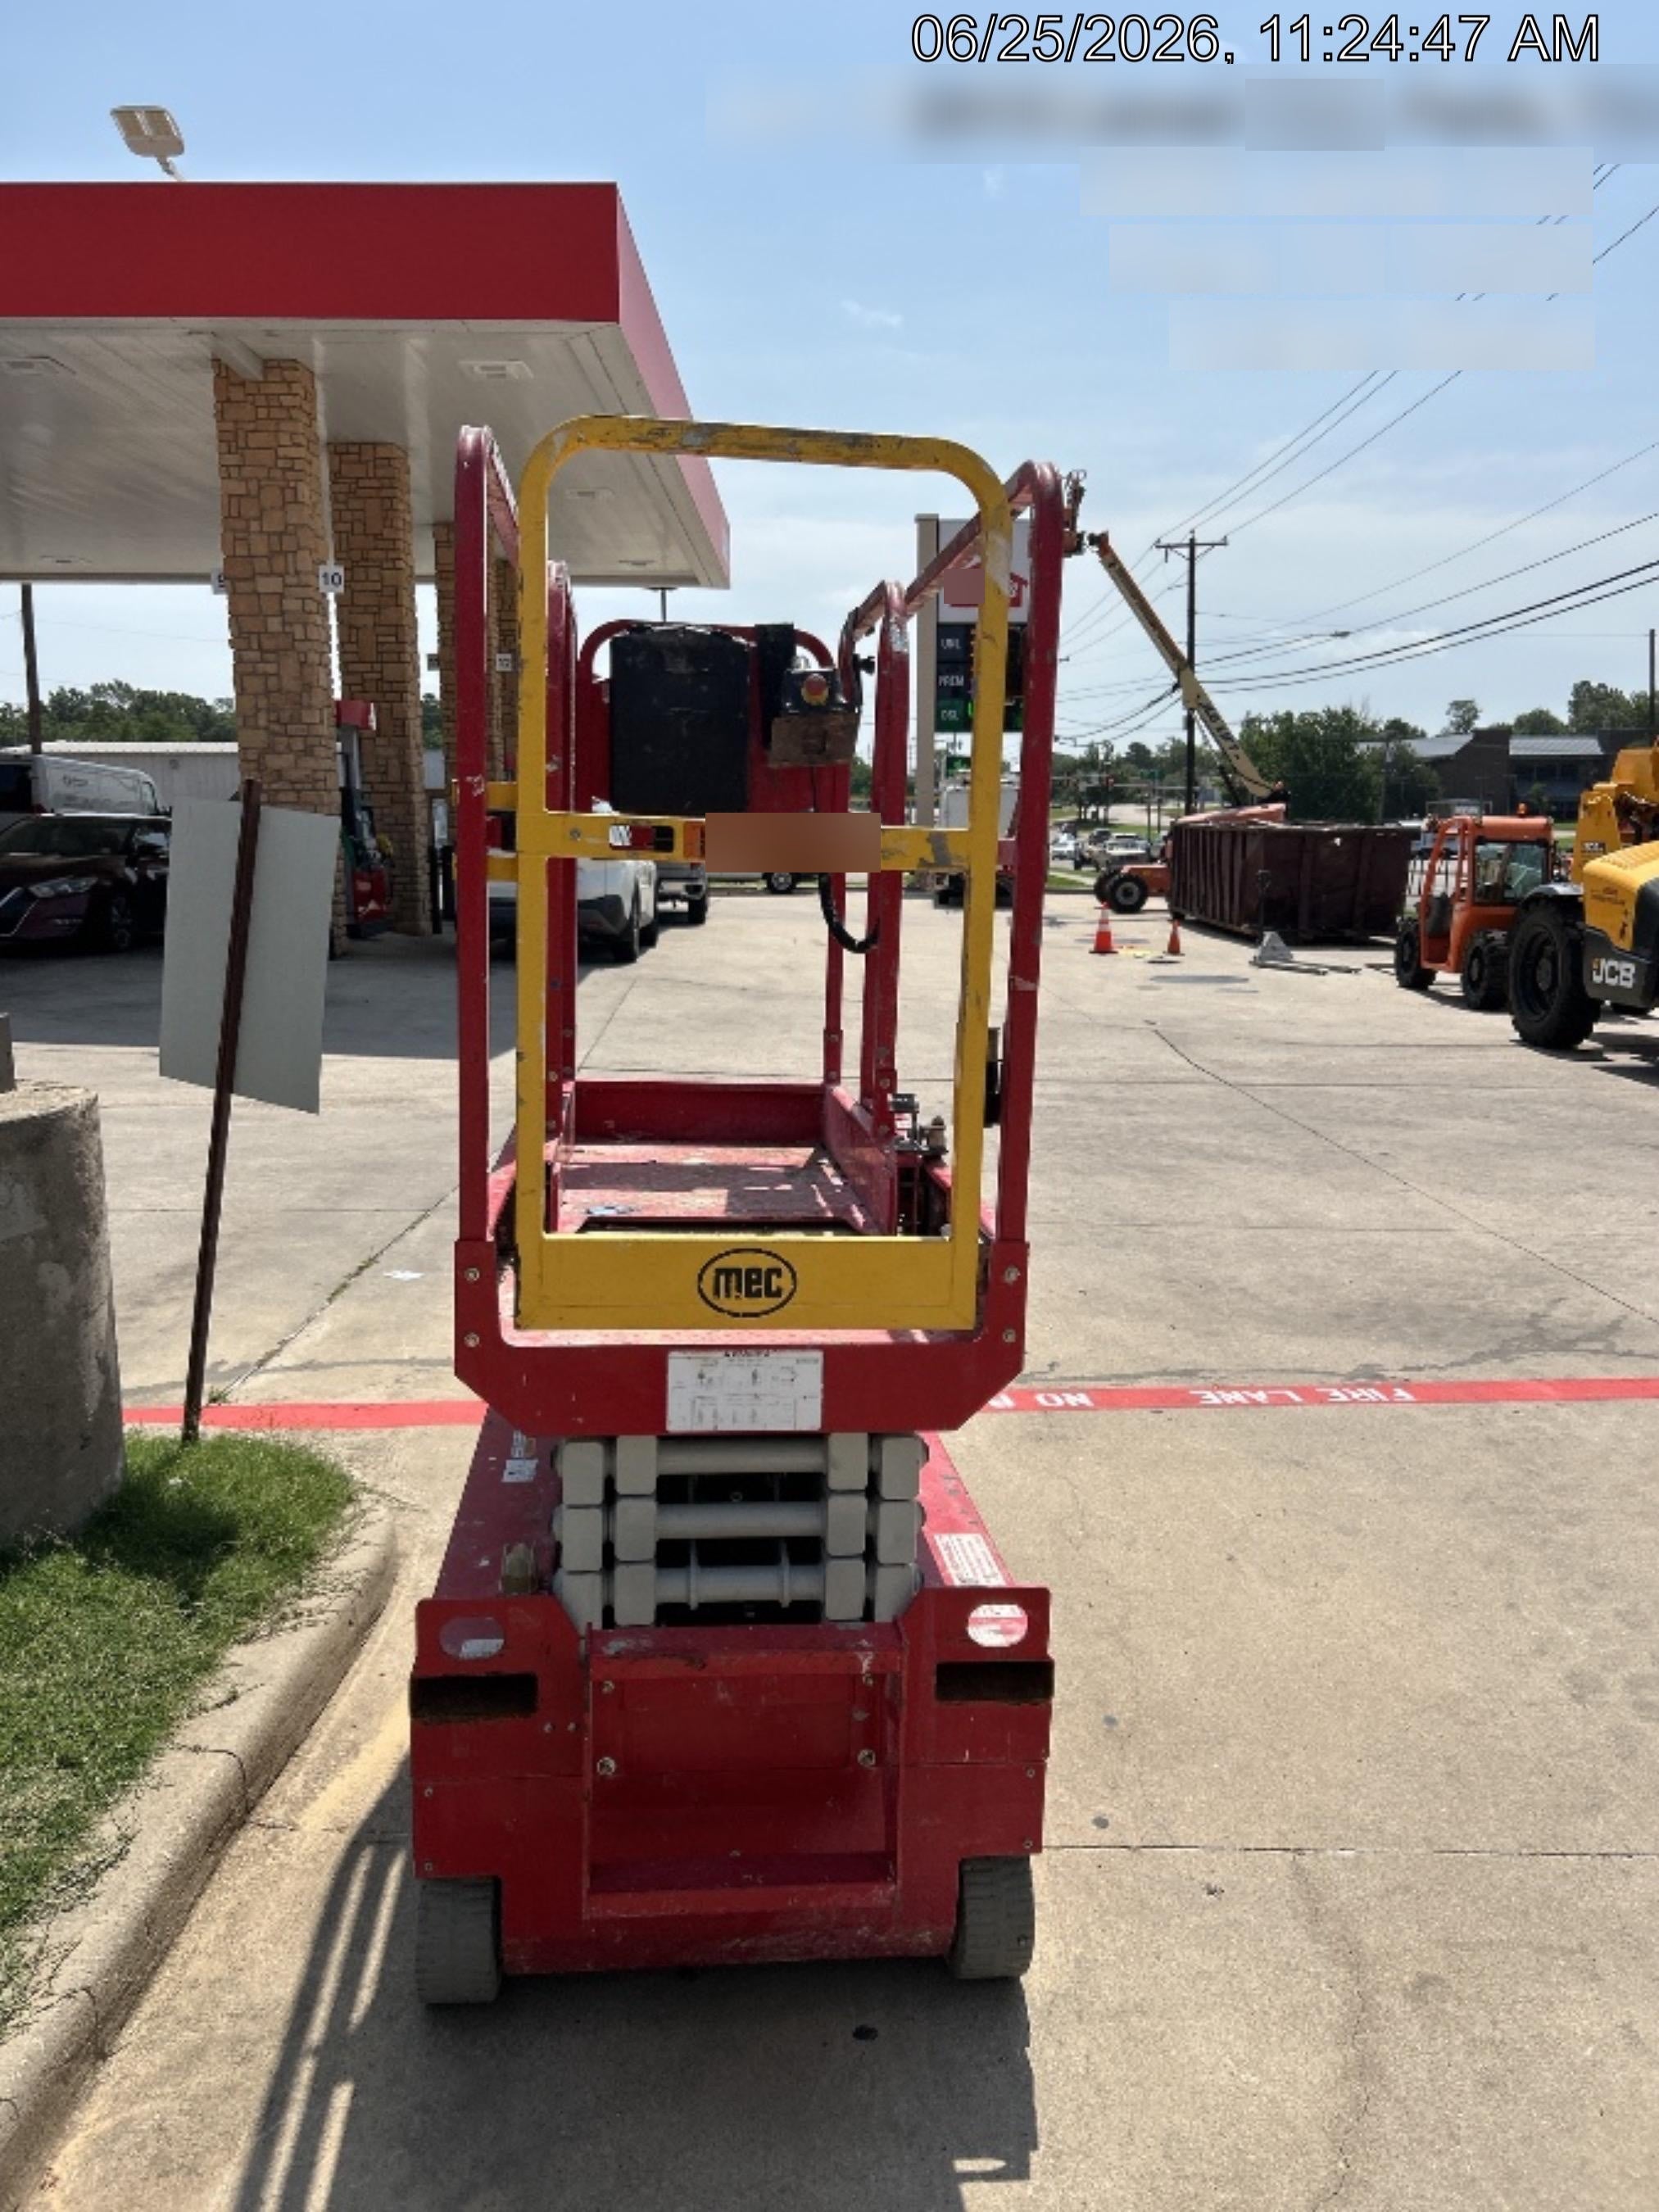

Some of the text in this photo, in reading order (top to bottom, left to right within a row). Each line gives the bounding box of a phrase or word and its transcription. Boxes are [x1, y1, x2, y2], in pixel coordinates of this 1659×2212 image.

[323, 573, 342, 586] 10
[1592, 957, 1635, 989] JCB
[1034, 1393, 1095, 1407] NO
[1189, 1387, 1416, 1404] FIRE LANE
